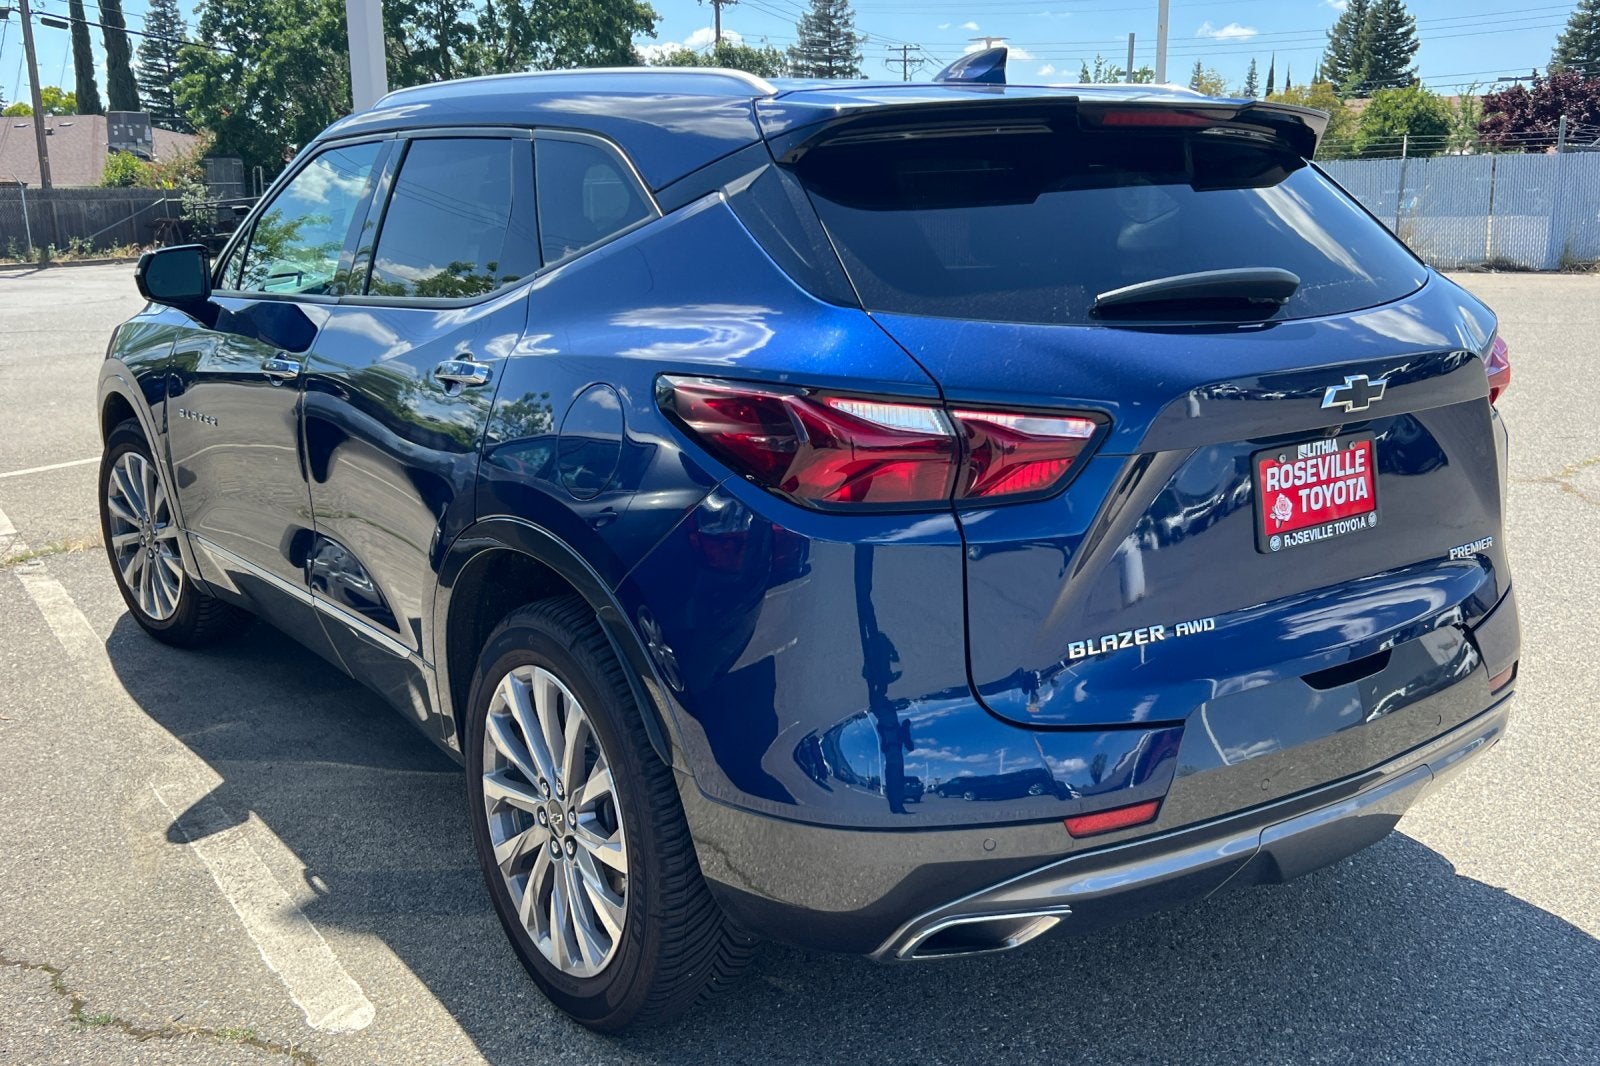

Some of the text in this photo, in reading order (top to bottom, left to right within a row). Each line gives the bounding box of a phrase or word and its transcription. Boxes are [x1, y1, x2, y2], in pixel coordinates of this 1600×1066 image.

[179, 408, 218, 426] BLAZER
[1307, 438, 1338, 457] LITHIA
[1266, 448, 1366, 492] ROSEVILLE
[1298, 476, 1368, 513] TOYOTA
[1284, 516, 1366, 547] ROSEVILLE TOYOTA
[1449, 536, 1493, 560] PREMIER
[1067, 617, 1215, 659] BLAZER AWD
